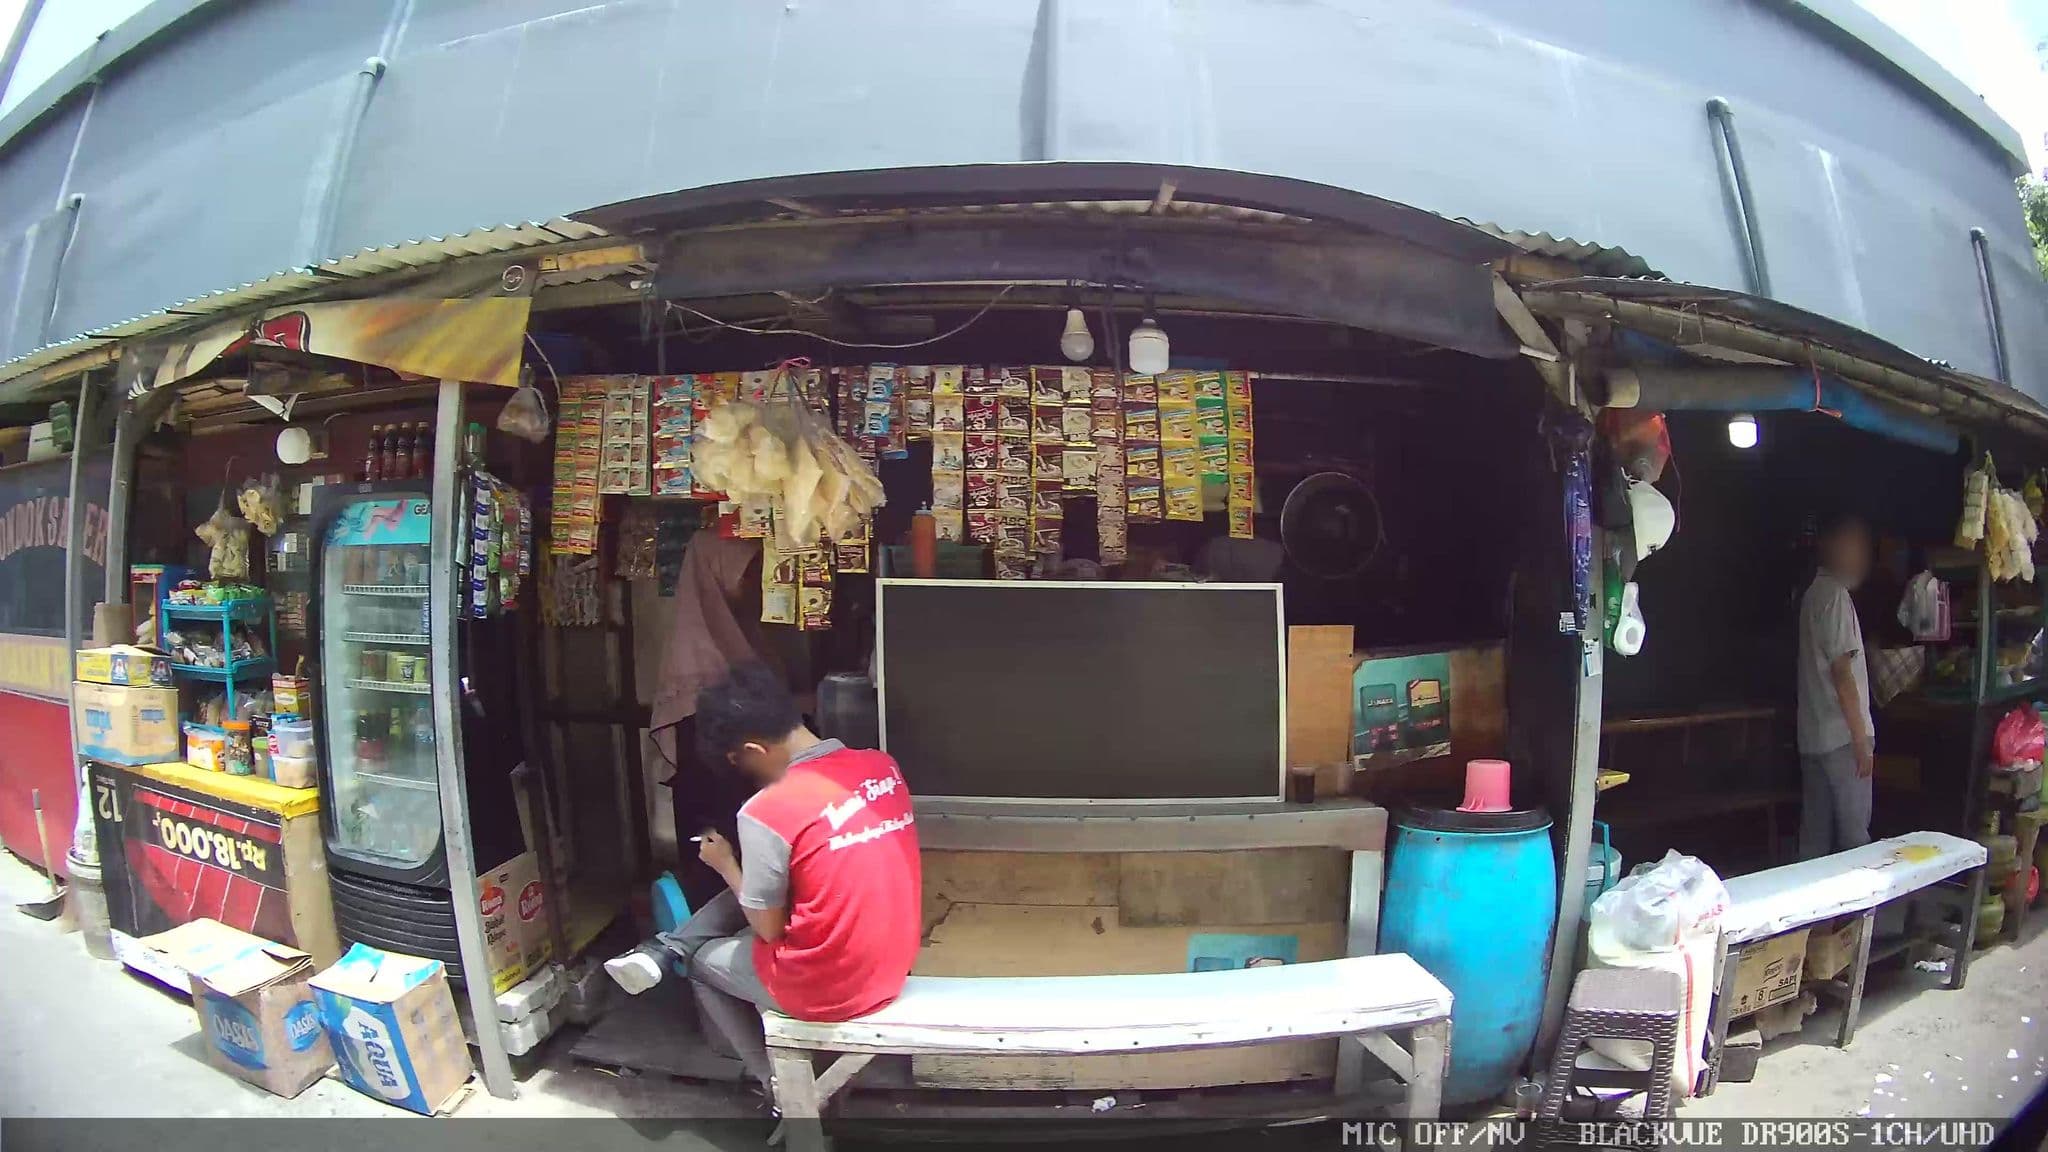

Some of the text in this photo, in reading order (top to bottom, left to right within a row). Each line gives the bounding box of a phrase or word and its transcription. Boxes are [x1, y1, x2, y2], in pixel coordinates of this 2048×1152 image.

[48, 496, 110, 566] SAER
[96, 785, 122, 822] 12
[213, 1013, 260, 1051] OASIS
[357, 1020, 398, 1088] AQUA
